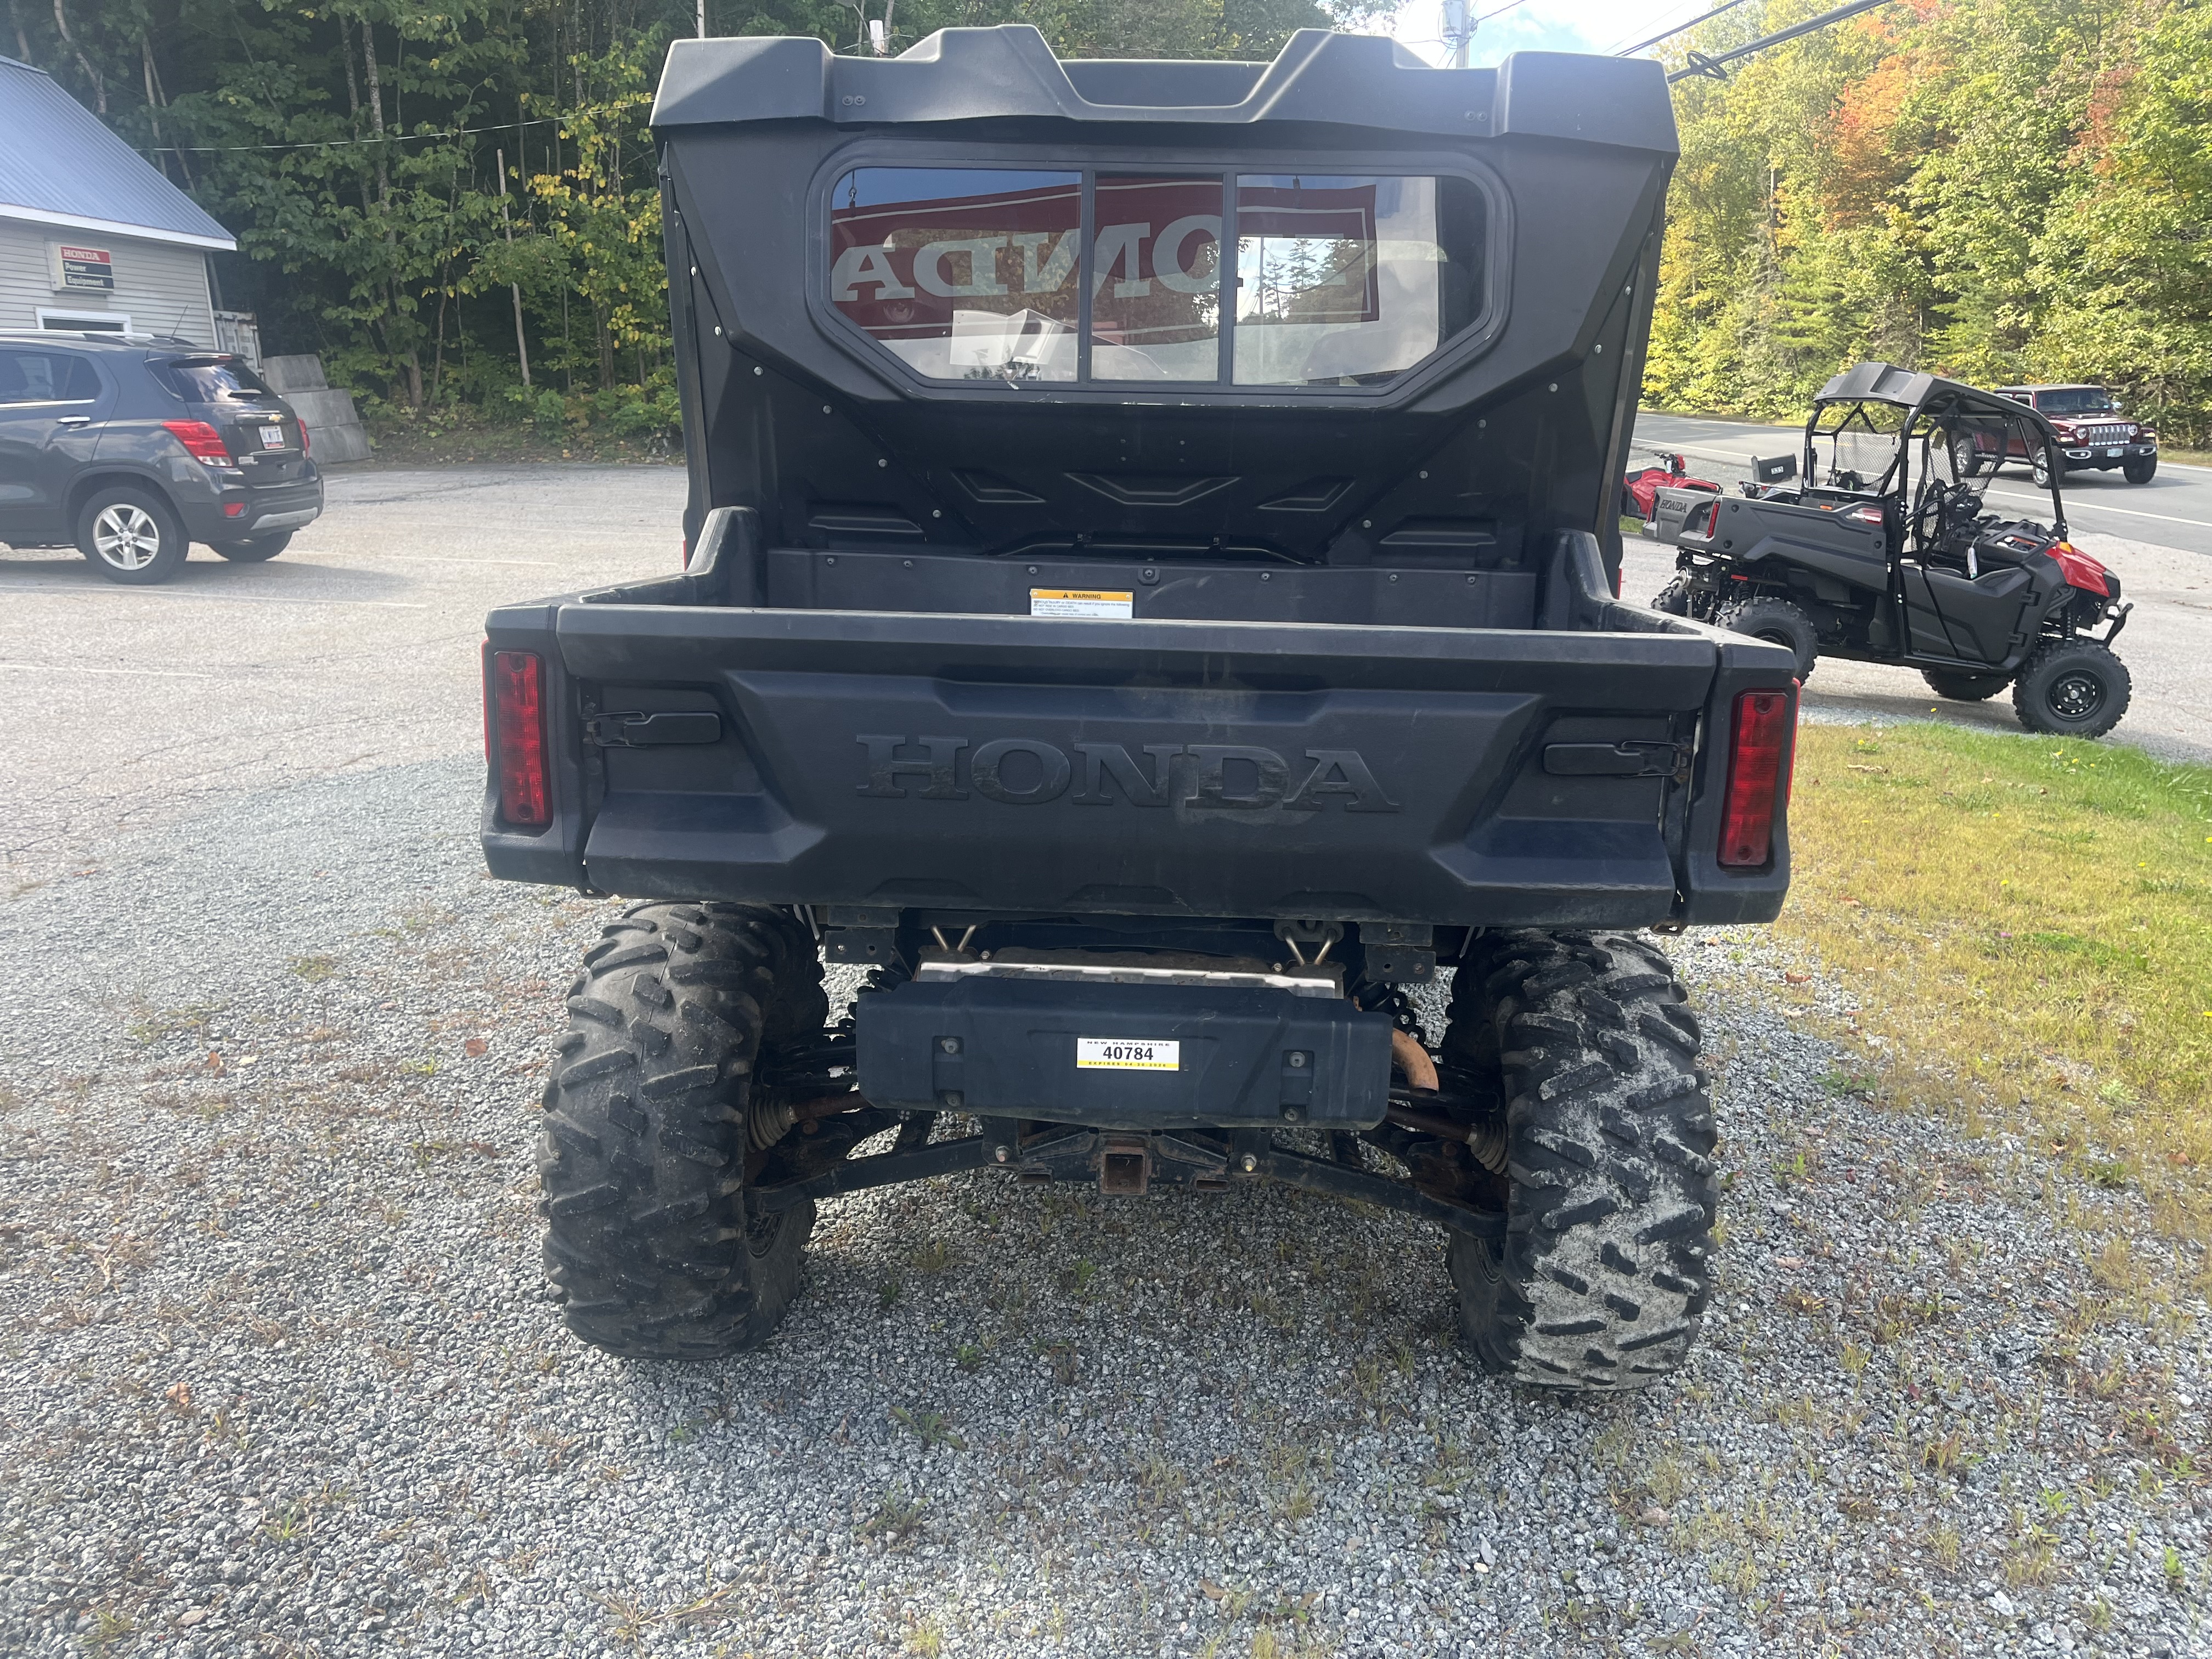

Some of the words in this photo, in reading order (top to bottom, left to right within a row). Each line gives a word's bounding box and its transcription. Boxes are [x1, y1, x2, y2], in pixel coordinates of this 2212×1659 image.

[62, 249, 100, 261] HONDA
[65, 262, 87, 272] Power
[67, 275, 104, 286] Equipment
[1660, 499, 1688, 513] HONDA
[856, 733, 1400, 813] HONDA
[1103, 1046, 1153, 1060] 40784
